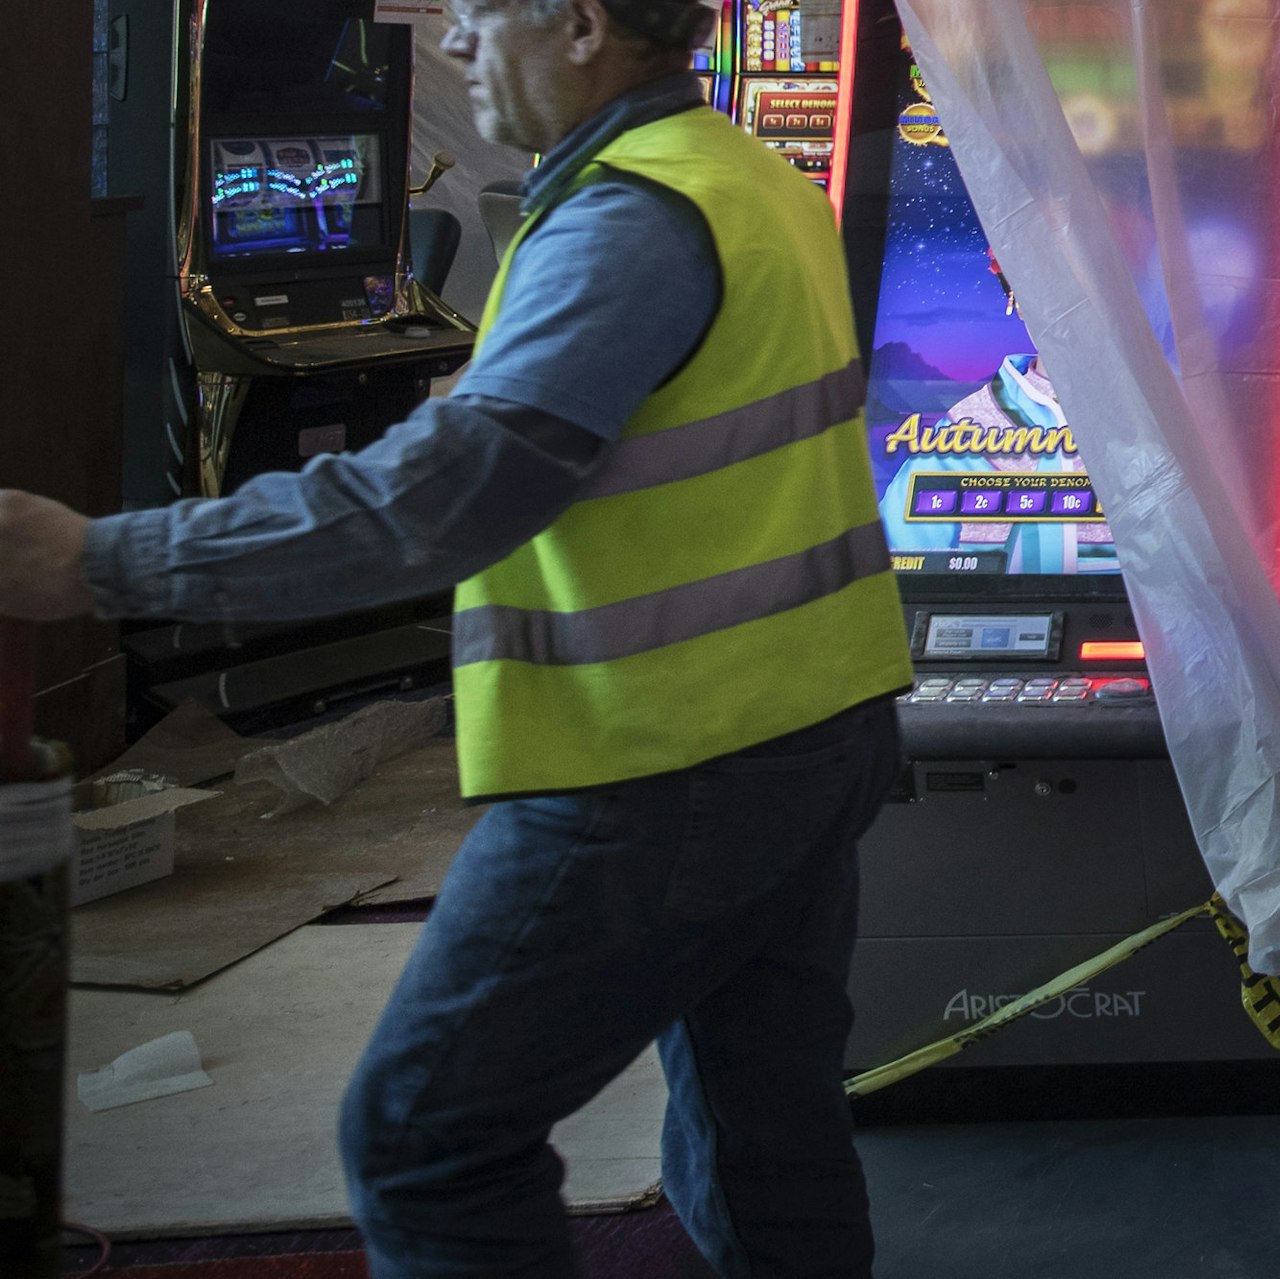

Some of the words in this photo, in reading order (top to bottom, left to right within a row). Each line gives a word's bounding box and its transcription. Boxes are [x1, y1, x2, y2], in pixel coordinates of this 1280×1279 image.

[886, 412, 1078, 454] Autumn
[960, 477, 1011, 487] CHOOSE
[1014, 477, 1047, 487] YOUR
[949, 557, 978, 570] $0.00
